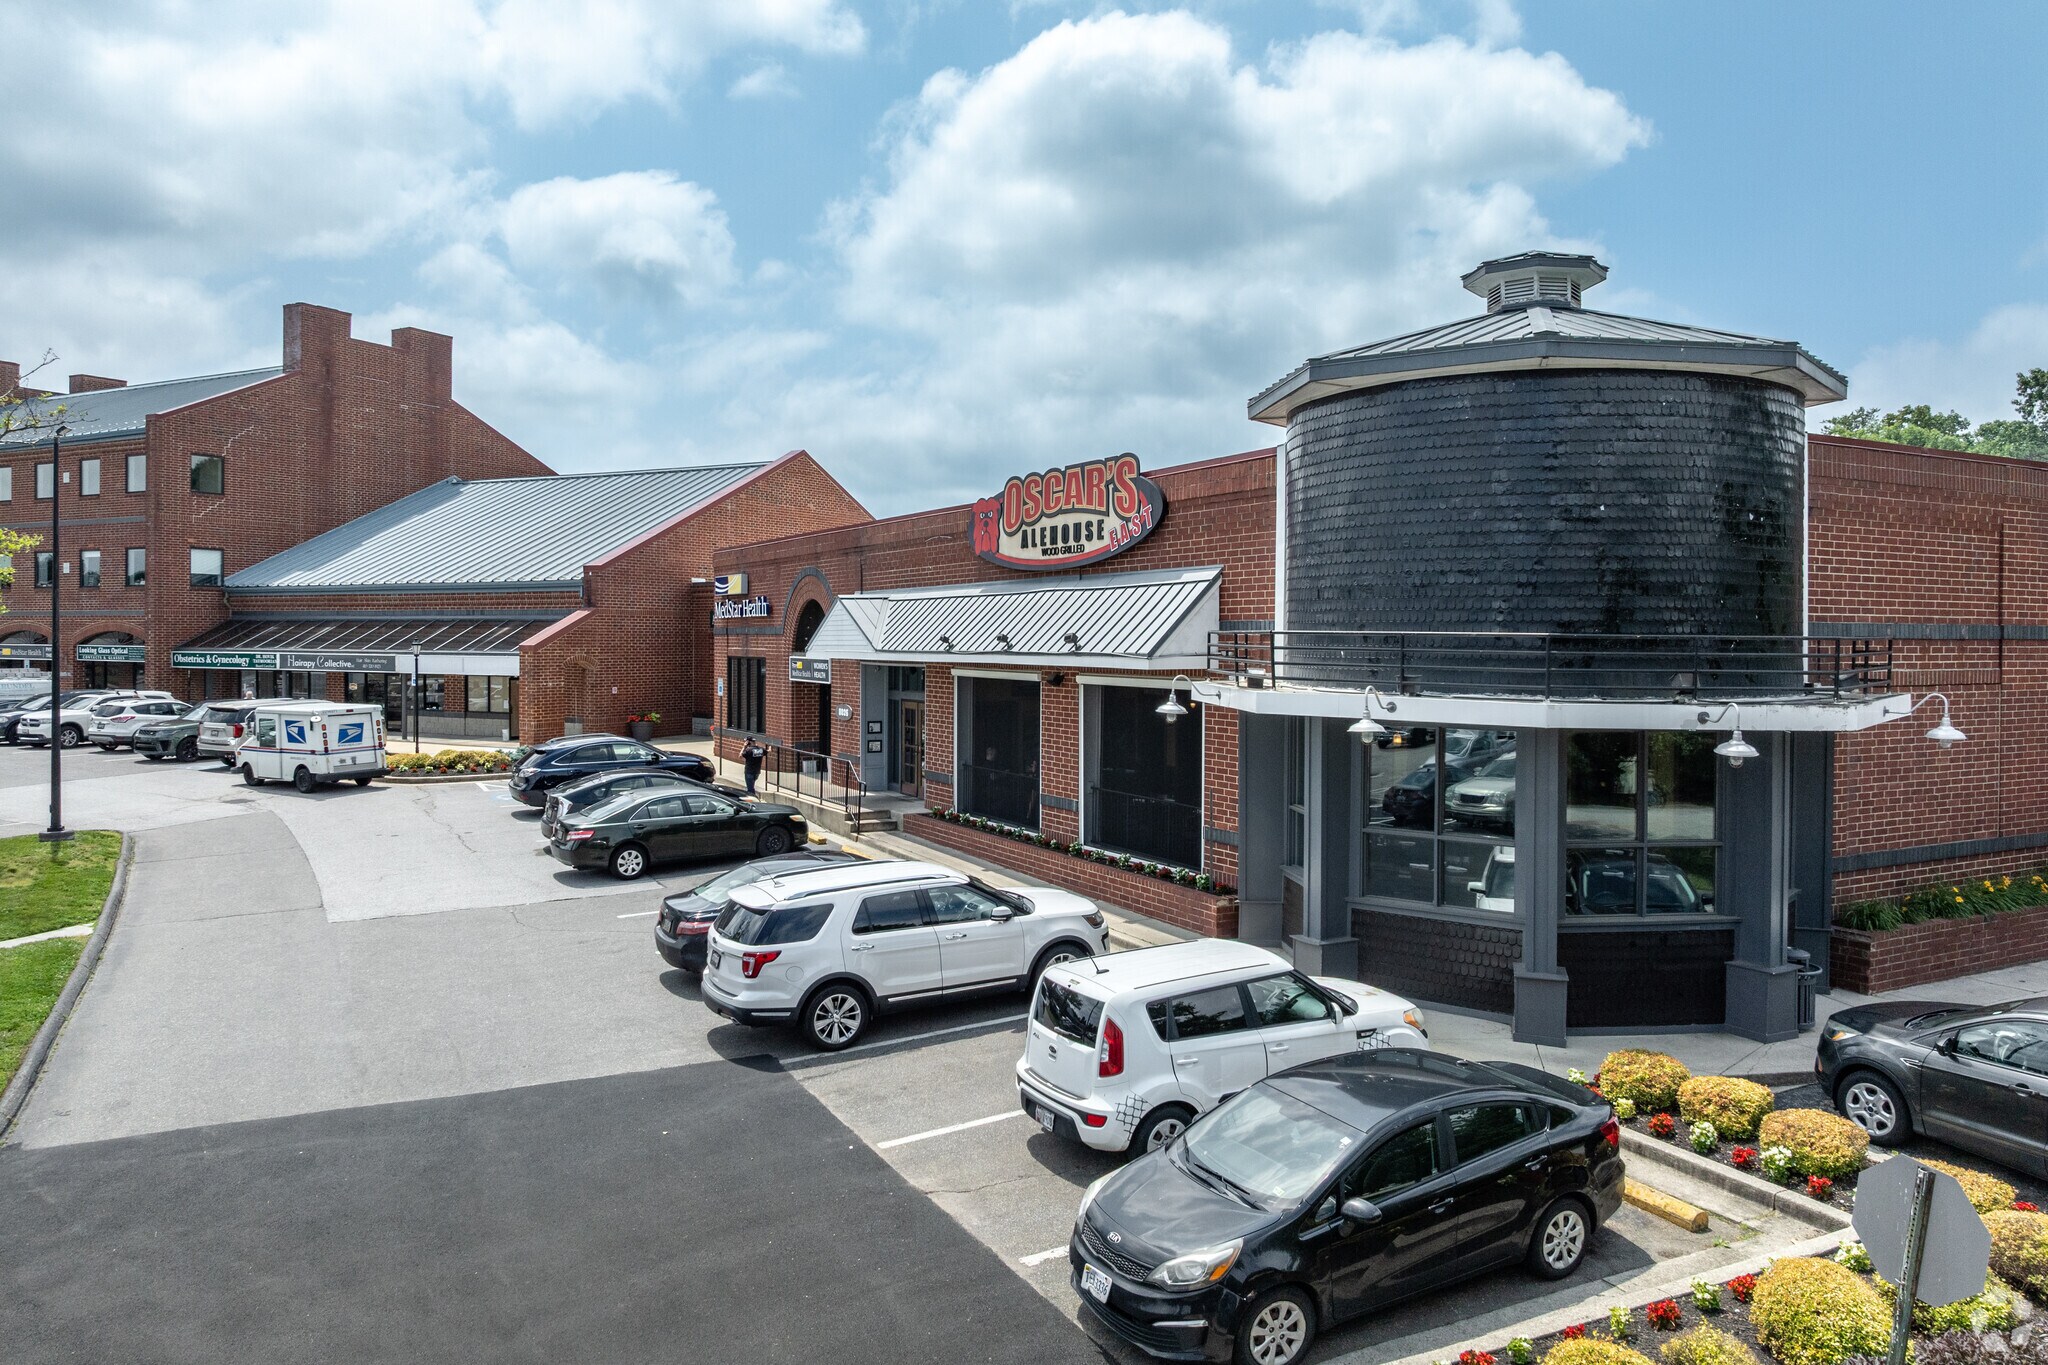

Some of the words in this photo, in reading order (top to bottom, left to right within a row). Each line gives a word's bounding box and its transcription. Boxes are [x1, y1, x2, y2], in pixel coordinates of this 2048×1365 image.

[1004, 457, 1137, 533] OSCAR'S
[1020, 519, 1105, 549] ALEHOUSE
[1109, 504, 1153, 552] EAST
[1041, 547, 1060, 557] WOOD
[1060, 544, 1085, 555] GRILLED
[715, 599, 741, 619] MedStar
[742, 596, 769, 617] Health
[79, 647, 97, 655] Looking
[111, 647, 128, 655] Optical
[174, 654, 205, 664] Obstetrics
[206, 654, 212, 664] &
[212, 655, 250, 667] Gynecology
[287, 655, 316, 669] Hairapy
[316, 655, 352, 668] Collective
